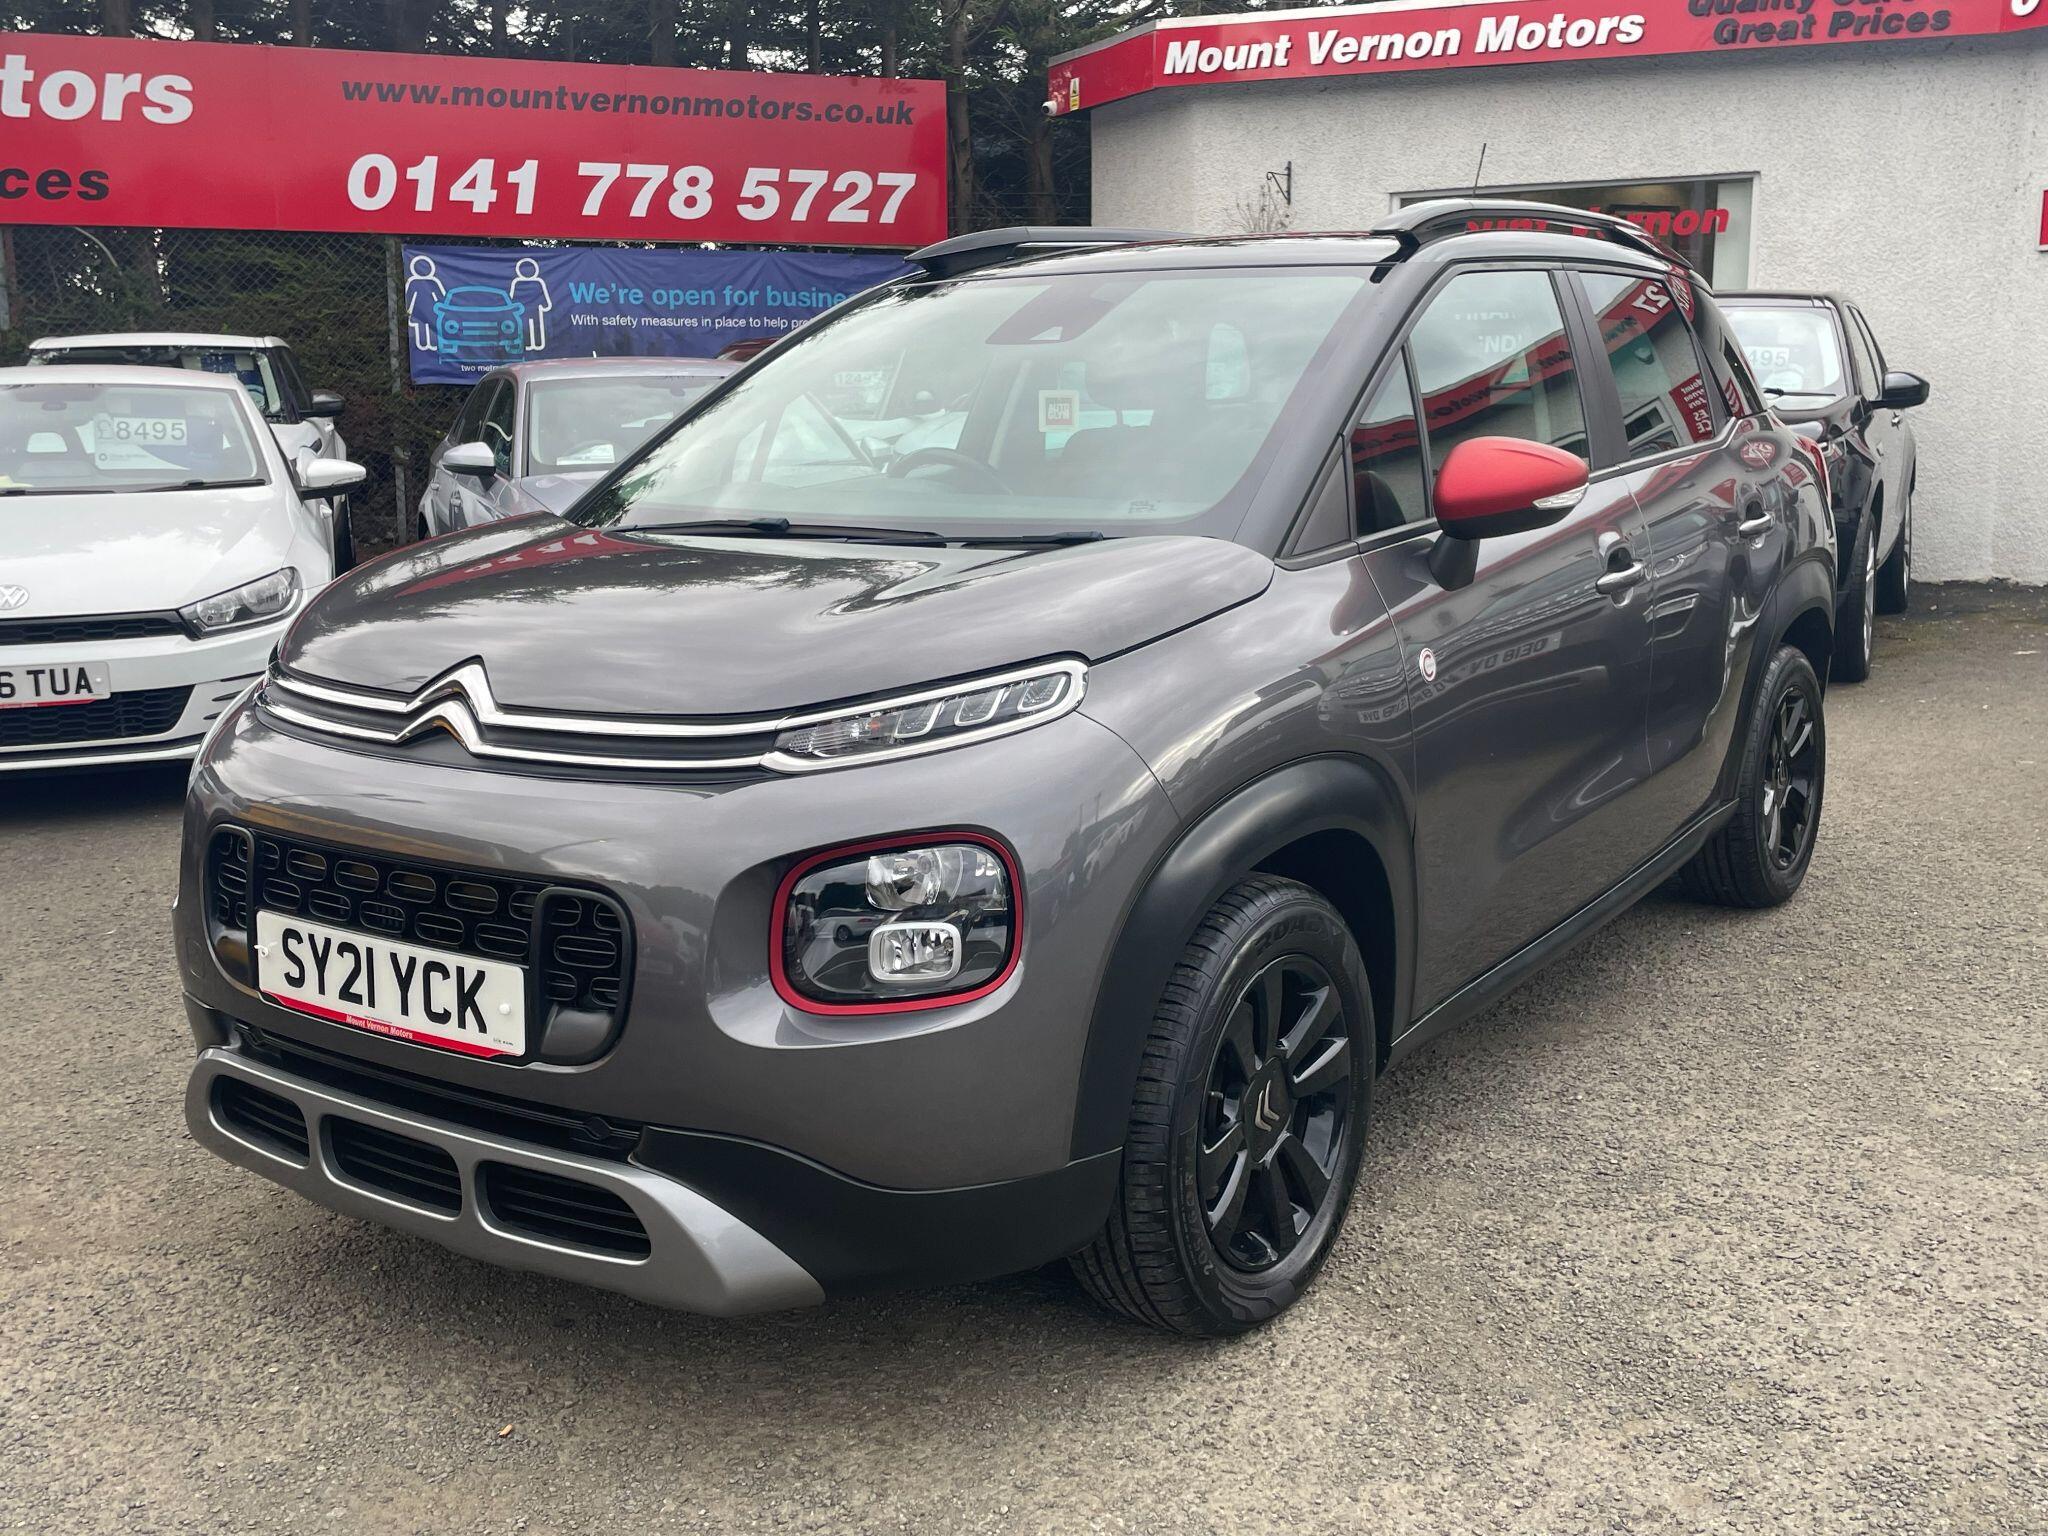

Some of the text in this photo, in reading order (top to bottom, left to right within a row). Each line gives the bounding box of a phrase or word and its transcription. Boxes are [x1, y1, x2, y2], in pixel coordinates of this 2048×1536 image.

[1713, 7, 1952, 45] Great Prices
[1163, 14, 1646, 75] Mount Vernon Motors
[0, 54, 194, 125] tors
[342, 80, 914, 126] www.mountvernonmotors.co.uk
[0, 168, 110, 201] ces
[347, 153, 917, 224] 0141 778 5727
[568, 282, 855, 310] We're open for busine
[570, 314, 599, 326] With
[602, 314, 638, 328] safety
[641, 317, 699, 328] measures
[701, 315, 712, 327] in
[715, 316, 746, 330] place
[749, 317, 760, 328] to
[763, 316, 788, 330] help
[461, 364, 498, 372] two metr
[26, 667, 94, 698] TUA
[282, 928, 488, 1034] SY21 YCK
[345, 1014, 366, 1029] Mount
[366, 1020, 390, 1034] Vernon
[390, 1026, 414, 1040] Motors
